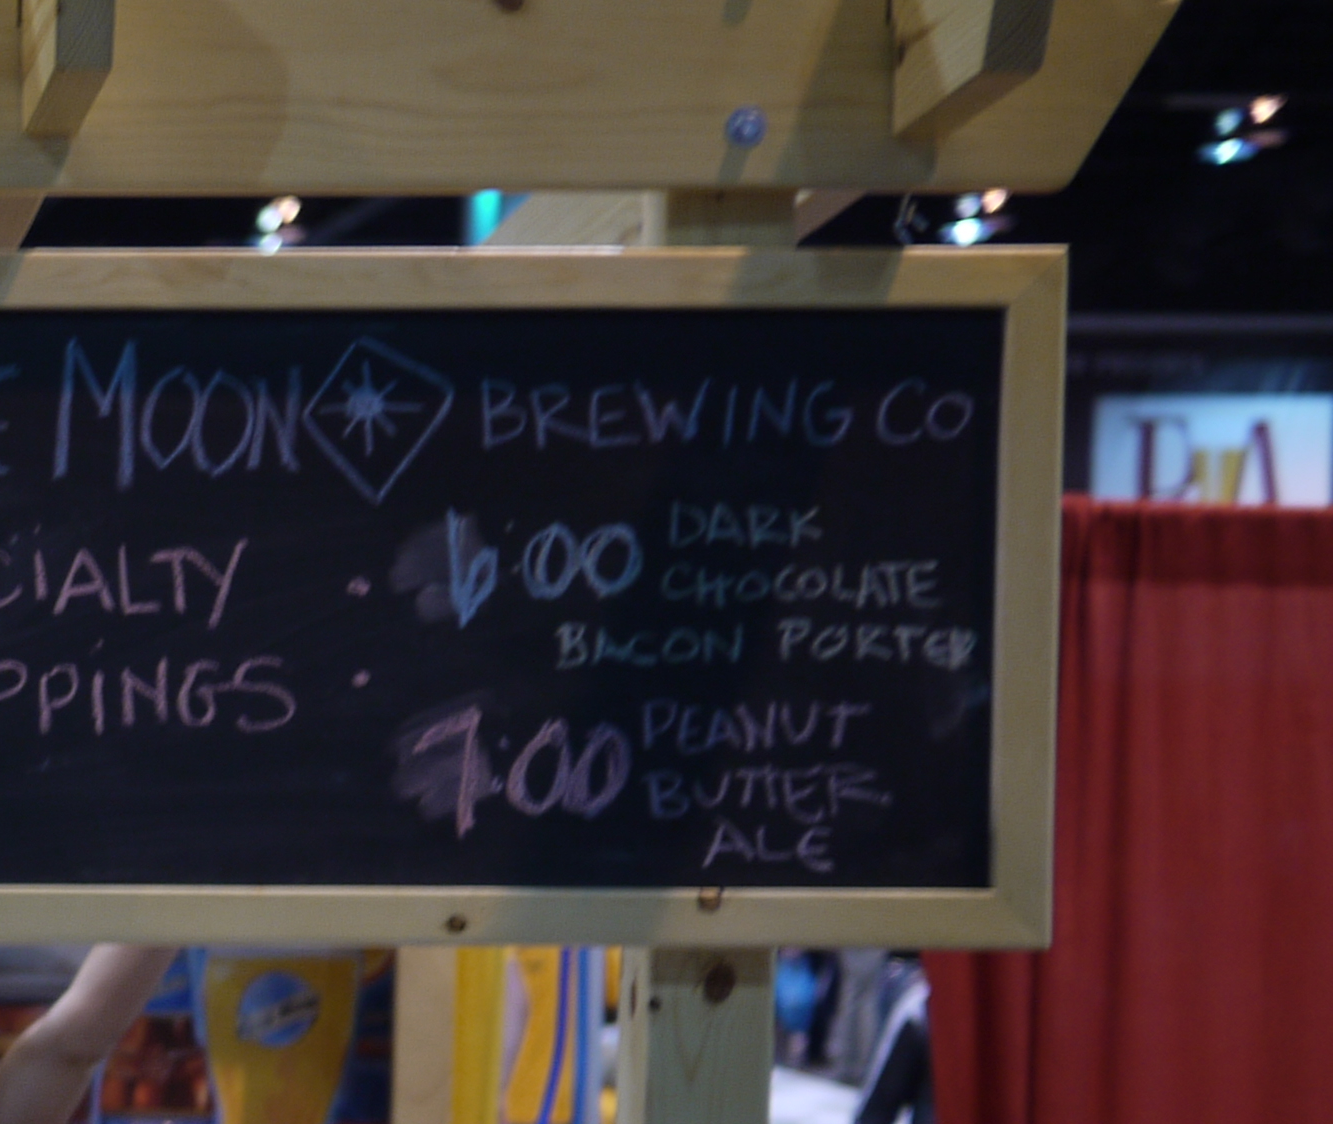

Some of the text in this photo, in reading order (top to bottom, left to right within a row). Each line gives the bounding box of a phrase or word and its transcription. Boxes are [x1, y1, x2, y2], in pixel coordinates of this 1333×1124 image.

[52, 338, 300, 487] MOON
[480, 377, 852, 450] BREWING
[877, 378, 974, 445] CO
[668, 501, 824, 549] DARK
[660, 561, 939, 608] CHOCOLATE
[556, 620, 975, 669] BACON PORTER
[643, 702, 872, 754] PEANUT
[643, 763, 891, 821] BUTTER
[702, 819, 833, 872] ALE
